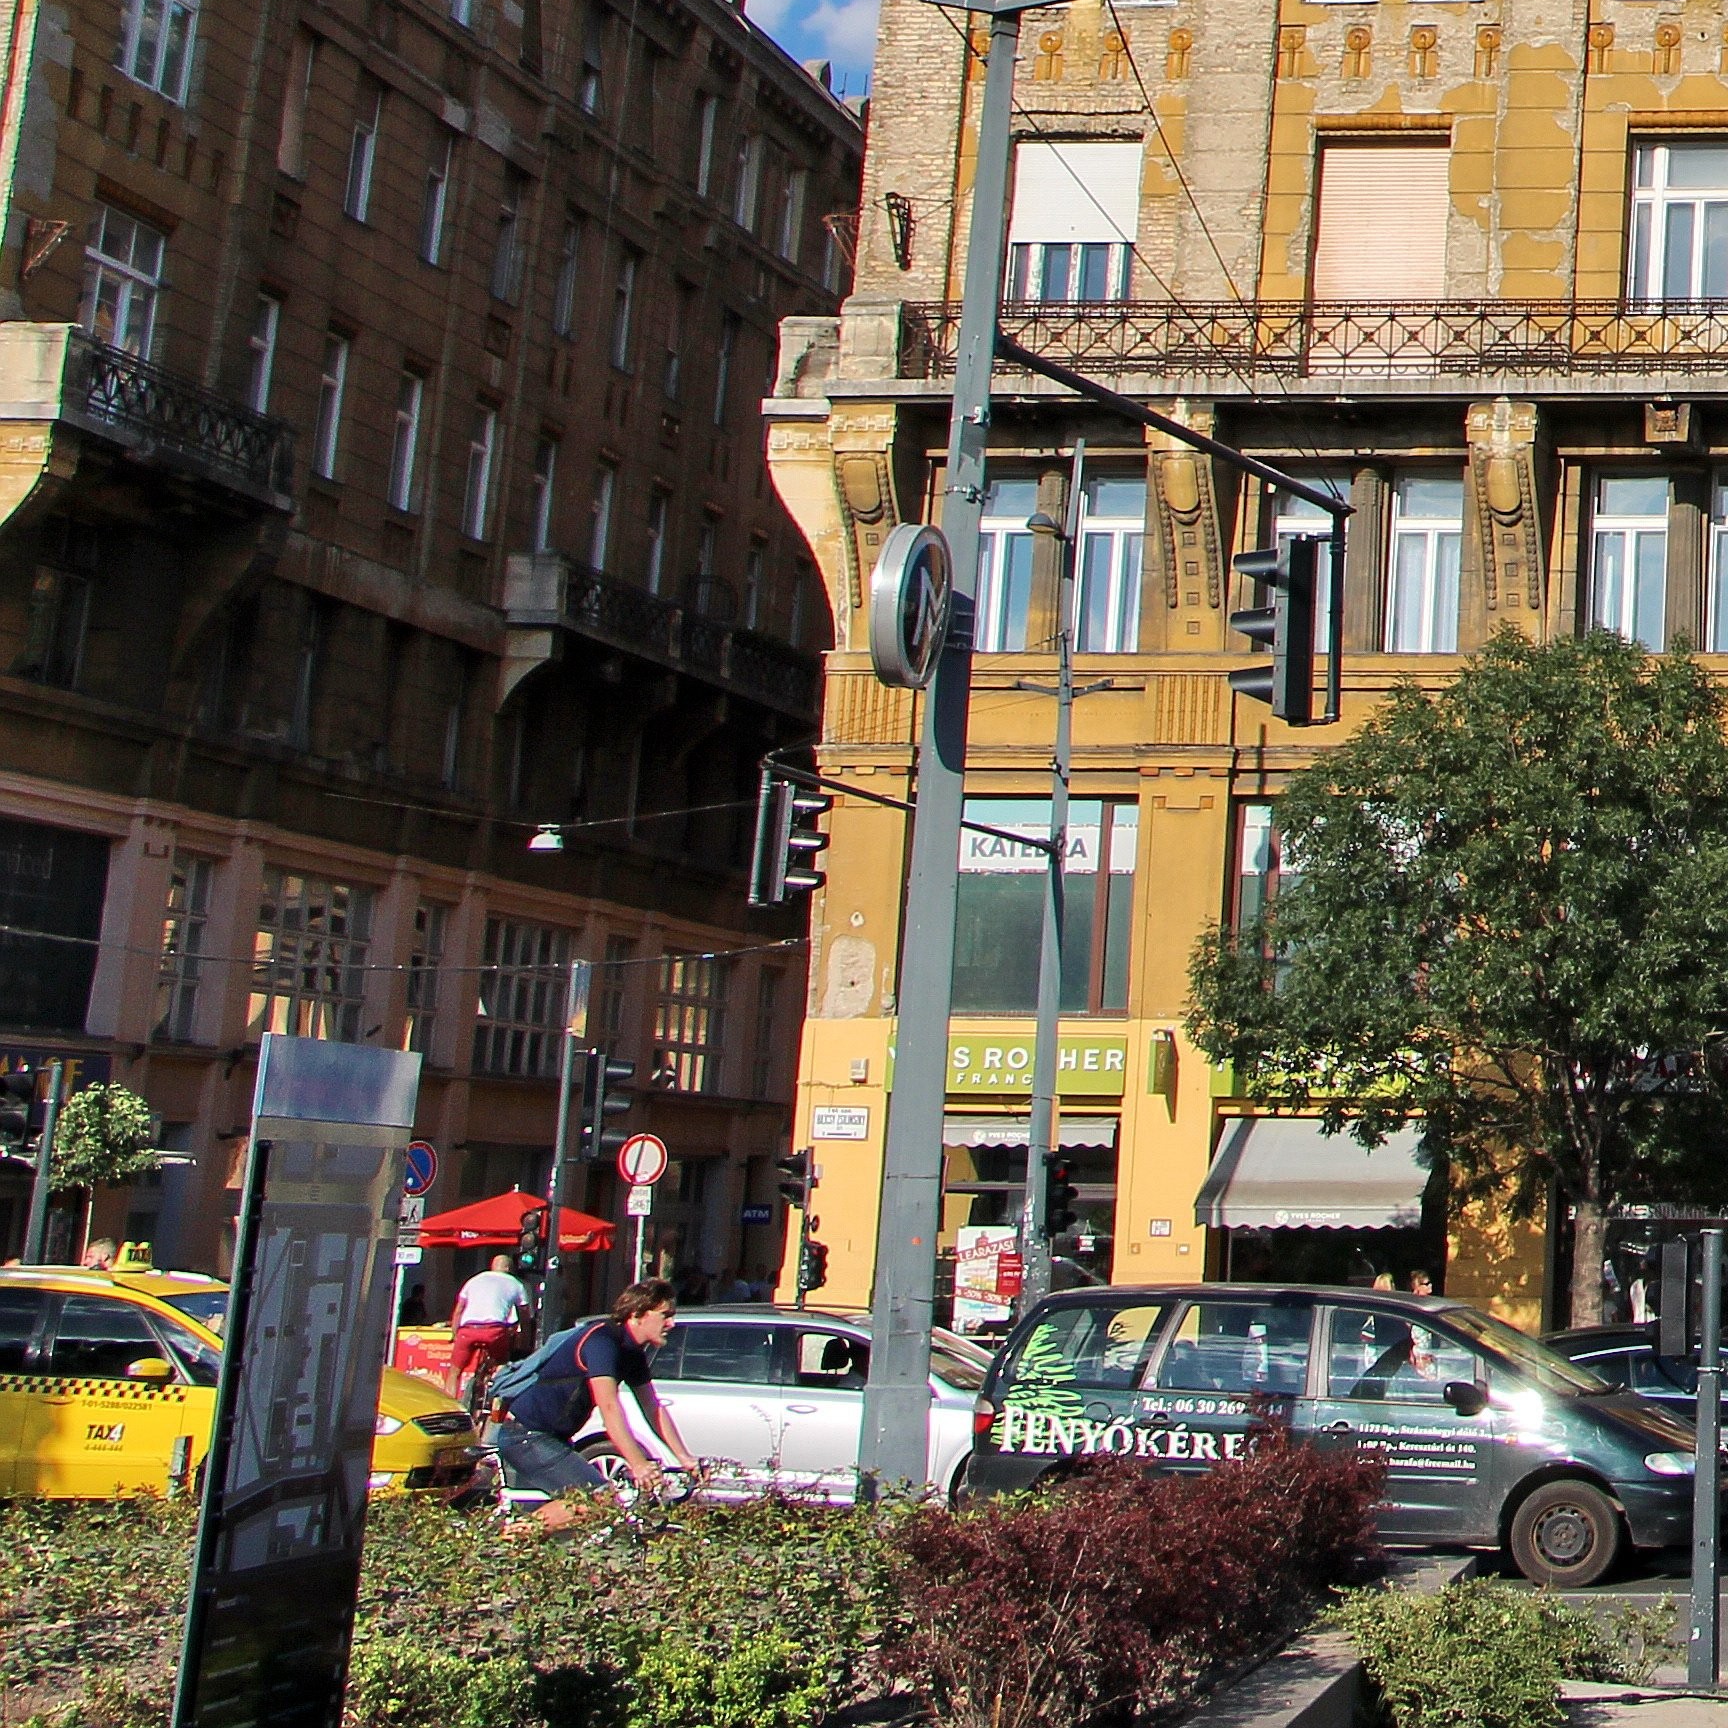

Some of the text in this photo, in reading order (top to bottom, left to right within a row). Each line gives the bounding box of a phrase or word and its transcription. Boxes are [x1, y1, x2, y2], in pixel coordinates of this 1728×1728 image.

[970, 836, 1088, 859] KATEDA
[983, 1047, 1126, 1071] ROHER
[956, 1073, 1034, 1086] FRANC
[743, 1209, 769, 1219] ATM
[1142, 1396, 1172, 1414] Tel.:
[1175, 1398, 1194, 1414] 06
[1196, 1399, 1216, 1415] 30
[1217, 1400, 1247, 1415] 269
